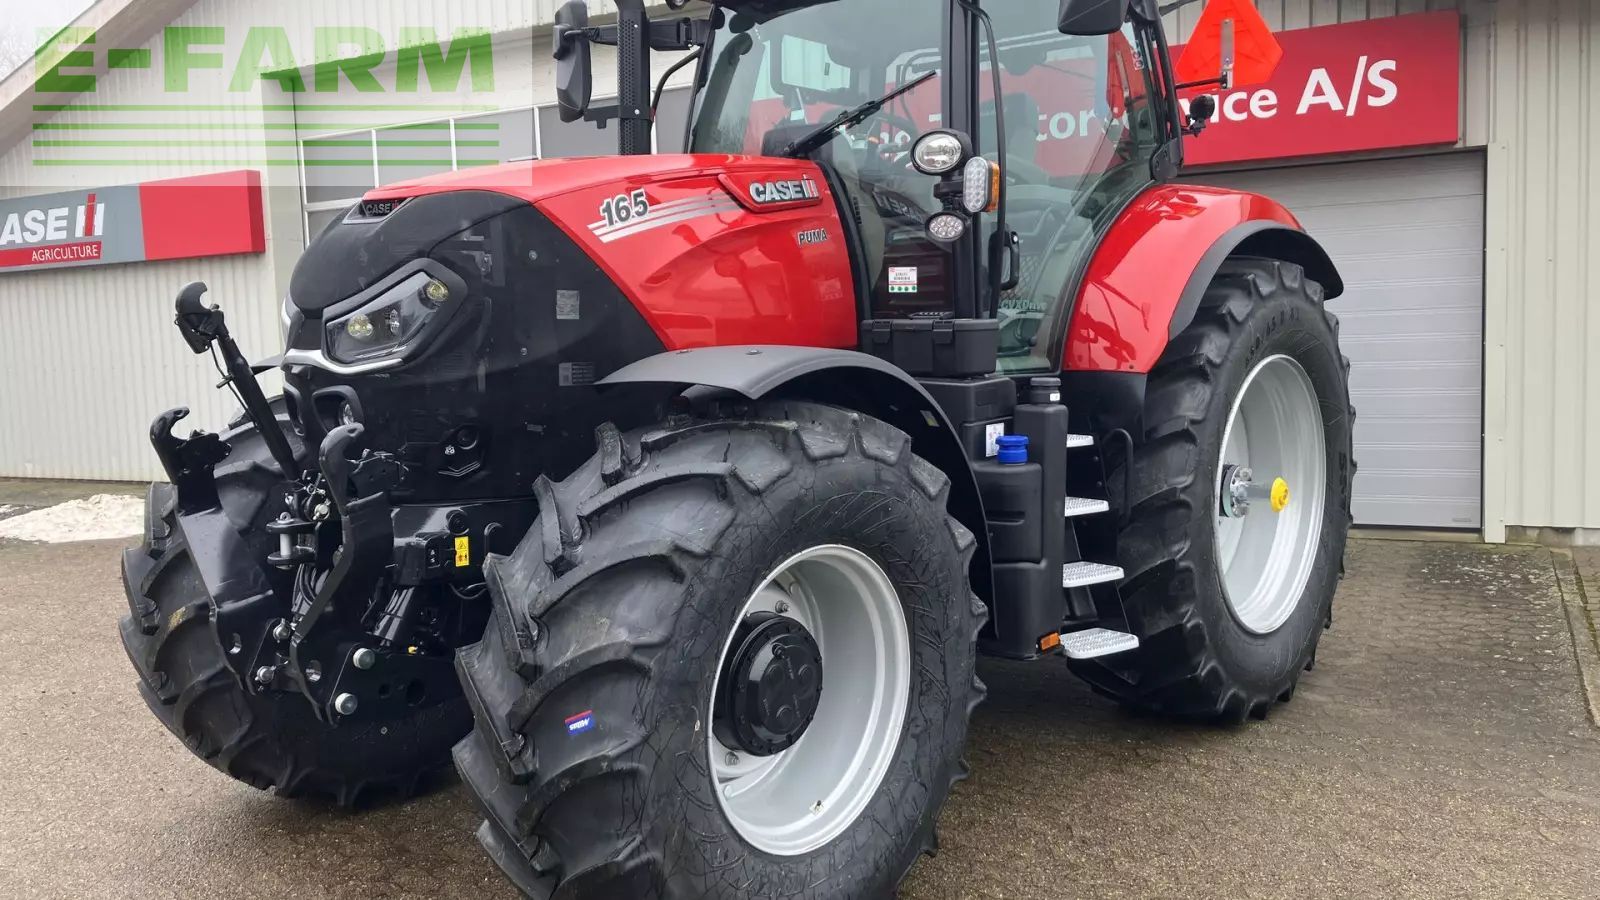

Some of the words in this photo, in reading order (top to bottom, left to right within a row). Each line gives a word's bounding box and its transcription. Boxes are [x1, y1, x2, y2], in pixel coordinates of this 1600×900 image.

[1296, 55, 1398, 117] A/S
[749, 181, 803, 202] CASE
[366, 203, 391, 214] CASE
[599, 187, 650, 228] 165
[0, 207, 69, 246] ASE
[797, 227, 828, 247] PUMA
[31, 244, 99, 262] AGRICULTURE
